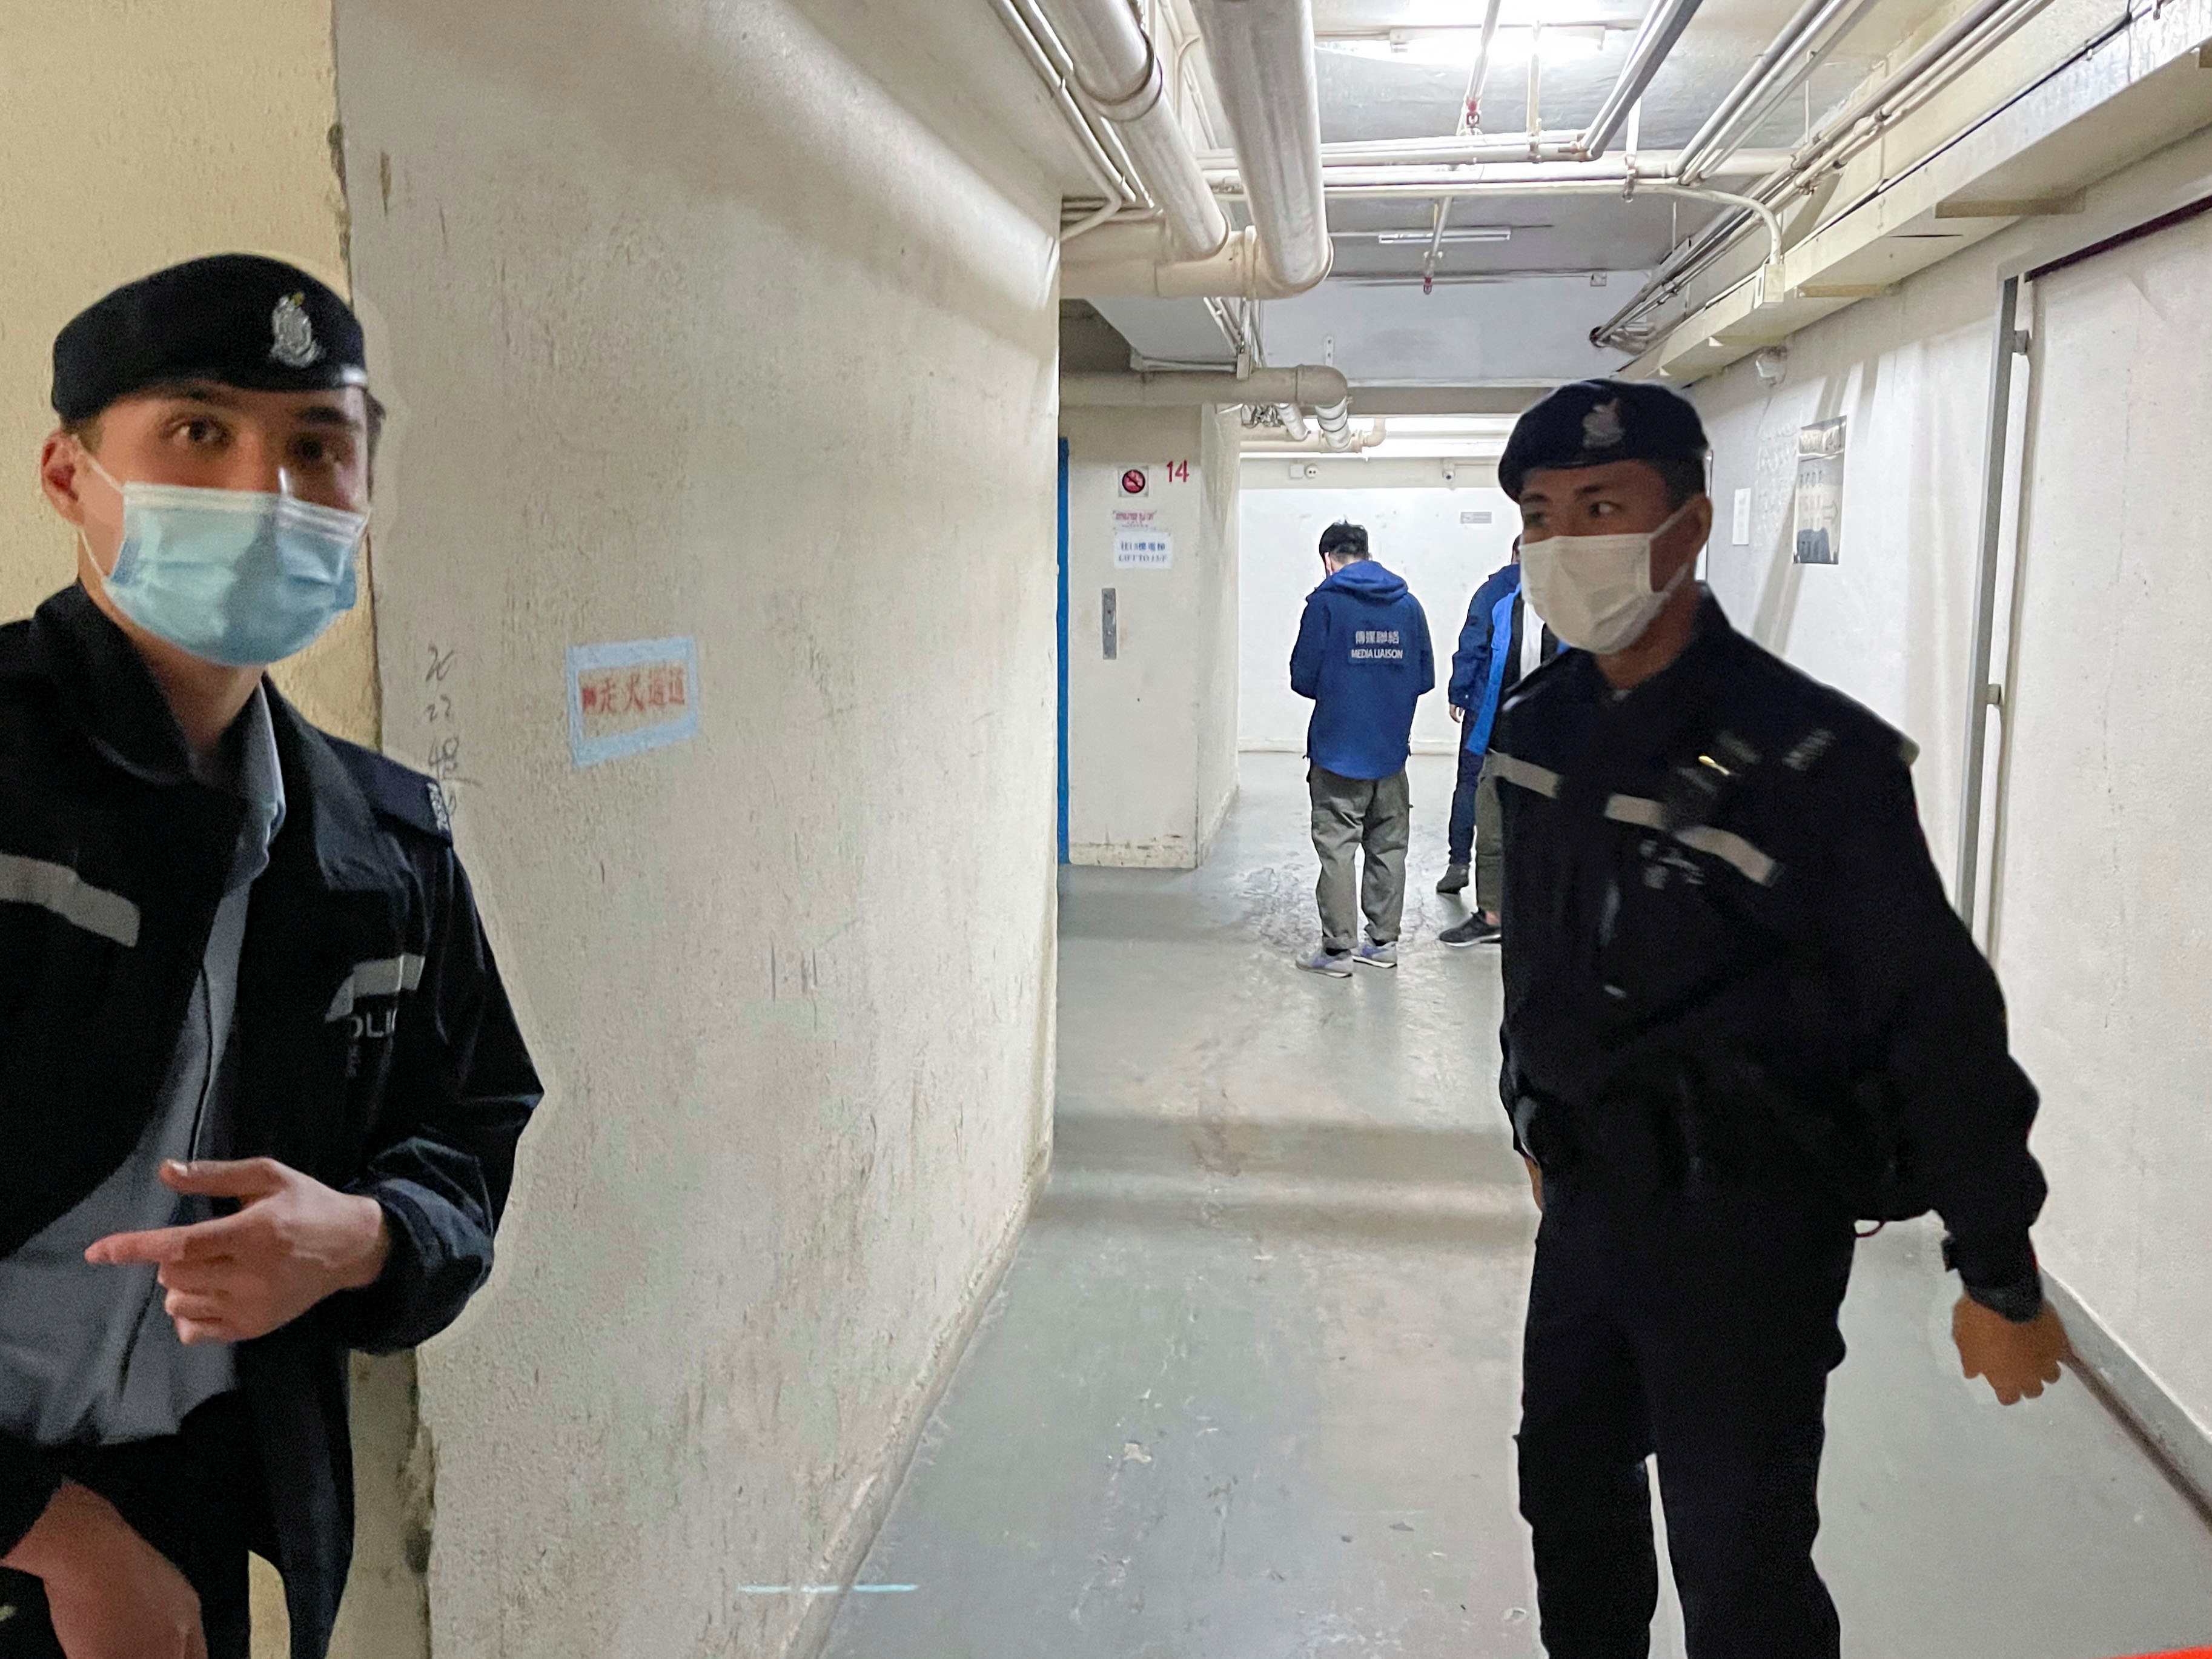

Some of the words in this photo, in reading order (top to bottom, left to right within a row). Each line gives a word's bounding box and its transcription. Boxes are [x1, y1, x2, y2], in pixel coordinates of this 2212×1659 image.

[1166, 459, 1190, 483] 14
[1351, 649, 1373, 658] MEDIA
[1374, 649, 1403, 659] LIAISON
